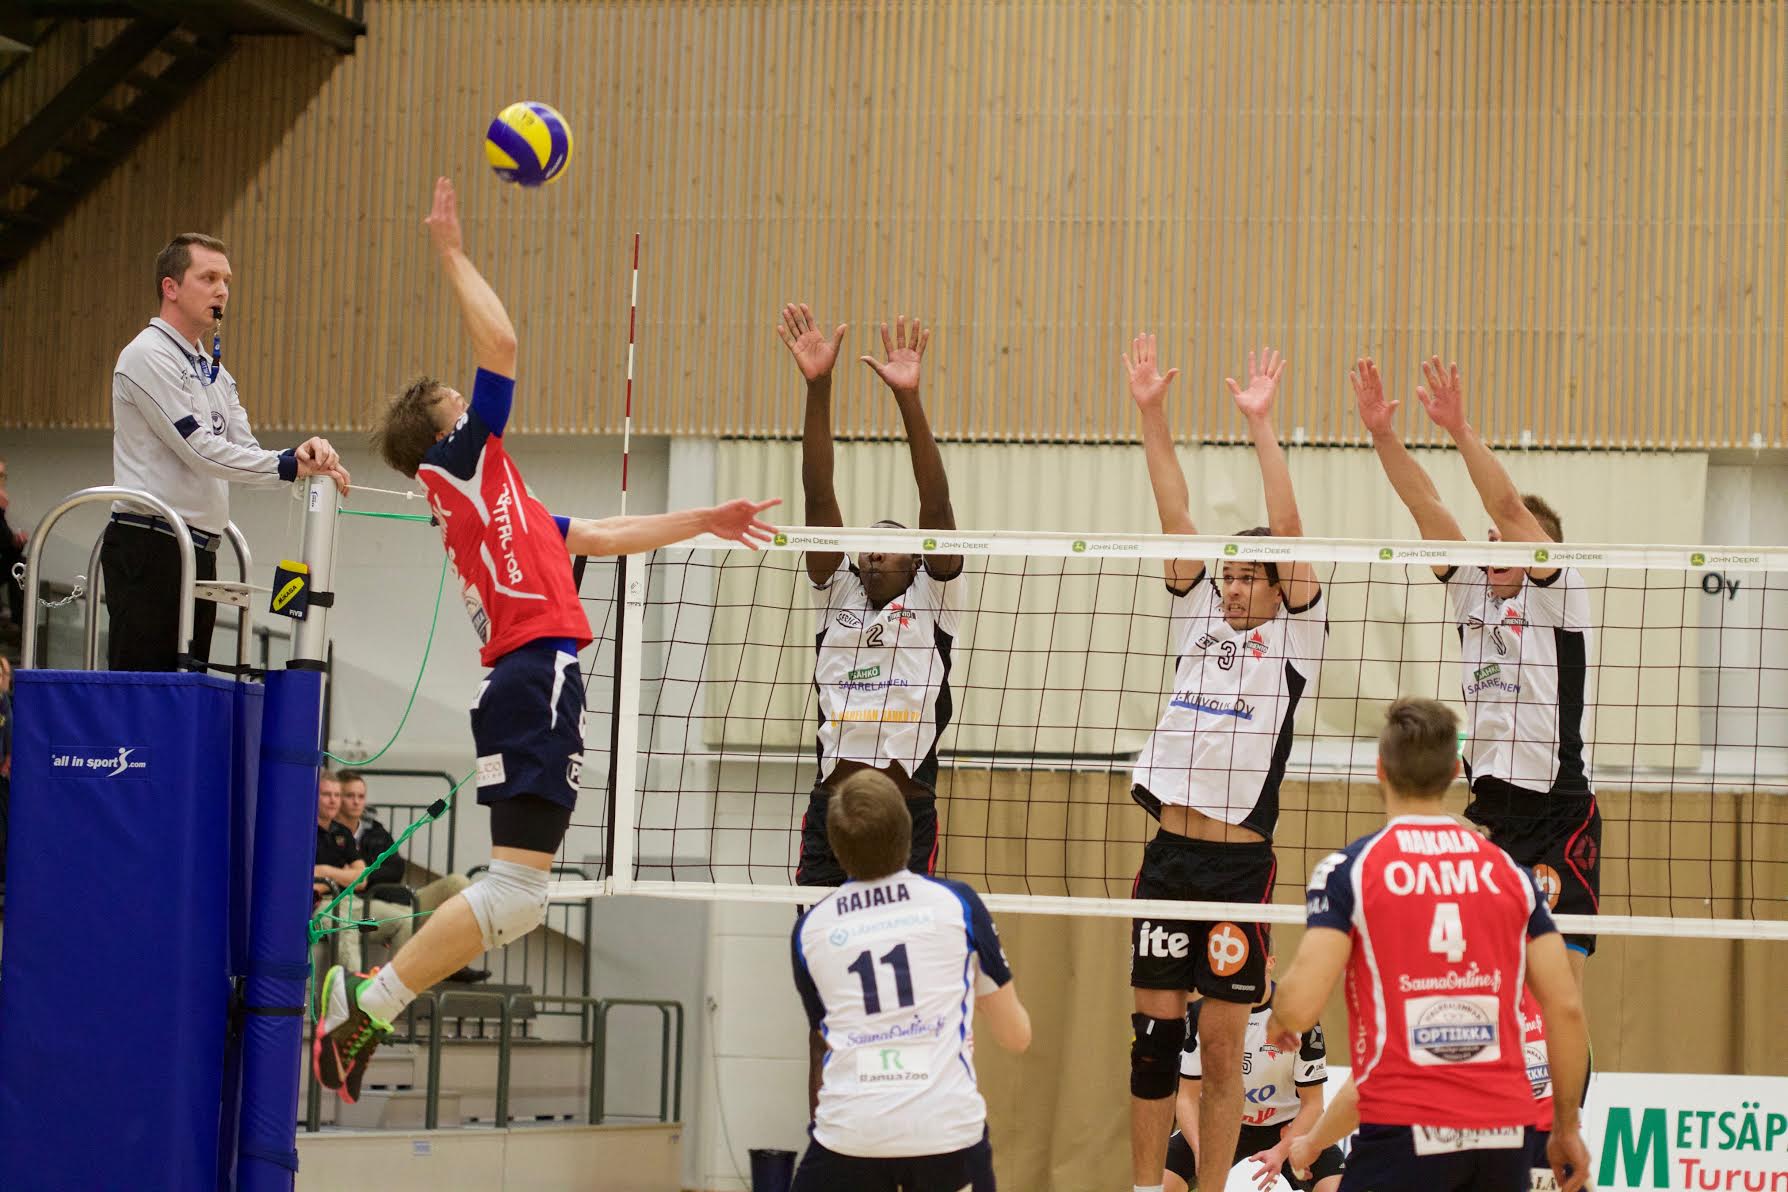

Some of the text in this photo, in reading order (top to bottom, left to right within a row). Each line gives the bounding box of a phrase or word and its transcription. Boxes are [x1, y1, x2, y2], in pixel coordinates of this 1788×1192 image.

[789, 536, 839, 546] JOHN DEERE
[962, 541, 989, 550] DEERE
[1088, 543, 1139, 551] JOHN DEERE
[1264, 547, 1291, 555] DEERE
[1420, 550, 1447, 558] DEERE
[1575, 552, 1603, 561] DEERE
[1732, 555, 1760, 564] DEERE
[1702, 572, 1740, 600] Oy
[866, 623, 884, 647] 2
[1217, 640, 1237, 671] 3
[53, 755, 70, 767] all
[71, 755, 84, 767] in
[836, 883, 911, 916] RAJALA
[1139, 921, 1190, 959] ite
[1428, 902, 1467, 963] 4
[848, 943, 915, 1015] 11
[1597, 1101, 1788, 1189] METSÄP
